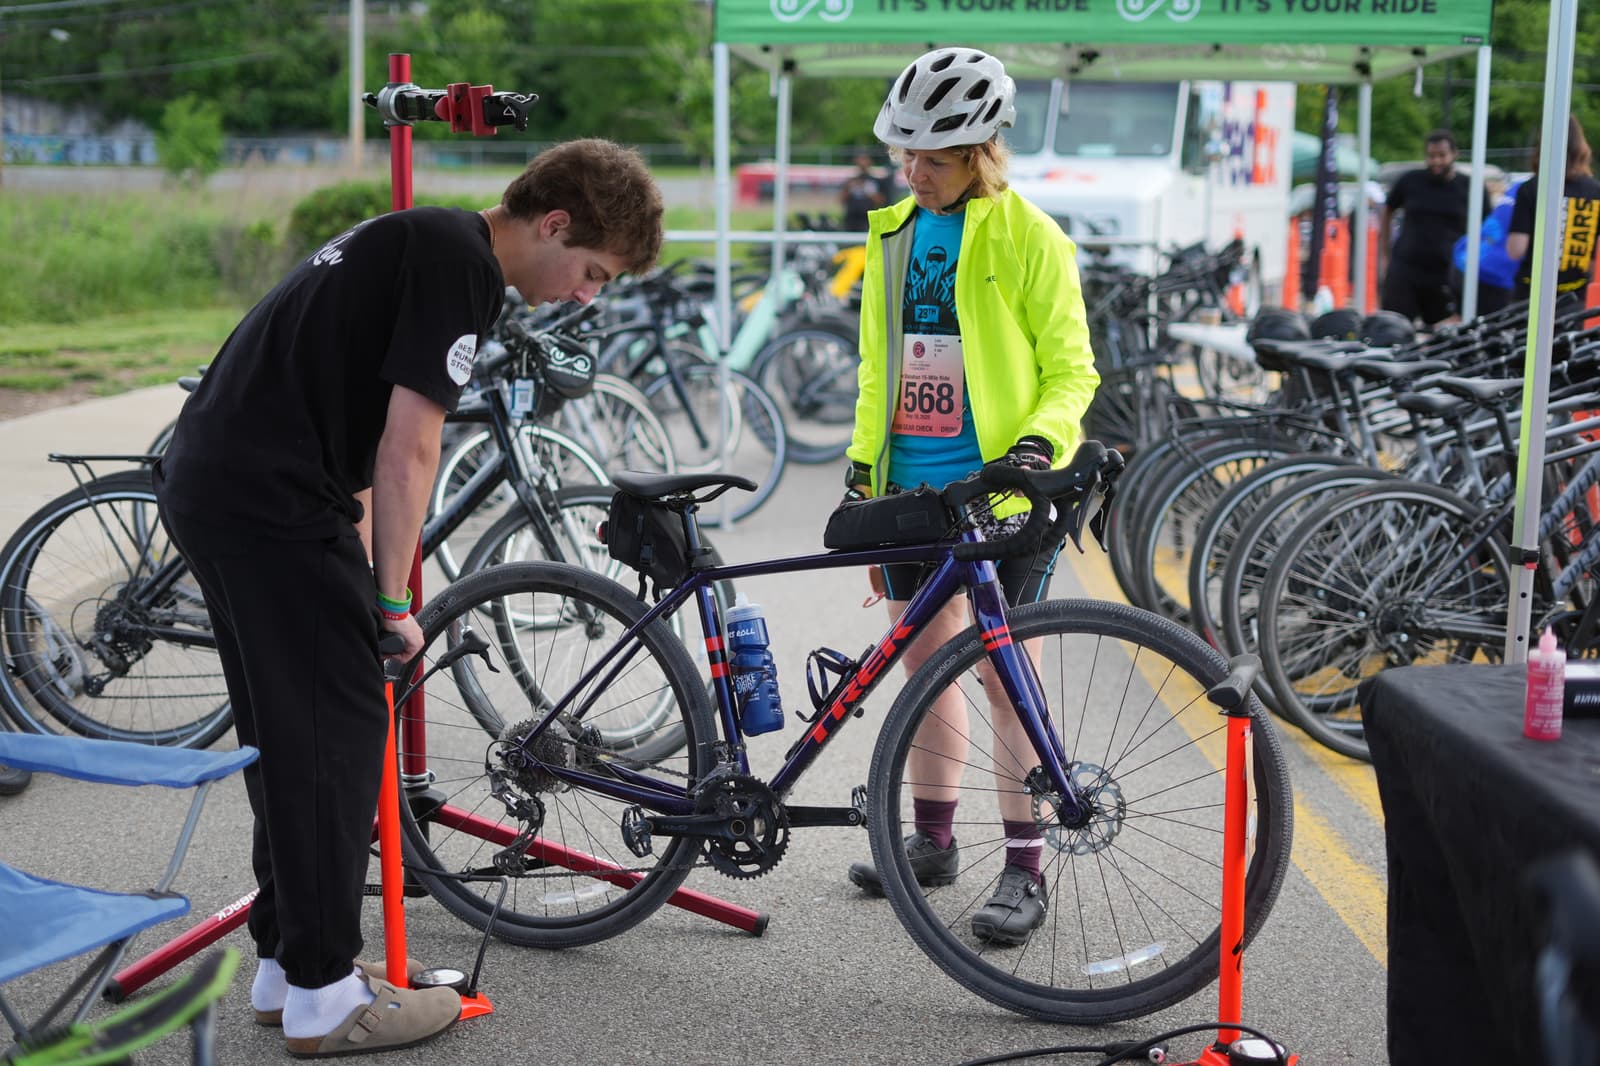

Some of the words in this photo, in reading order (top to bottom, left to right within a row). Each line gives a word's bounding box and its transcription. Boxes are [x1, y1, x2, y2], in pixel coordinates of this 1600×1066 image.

[938, 0, 1015, 13] YOUR
[1023, 0, 1090, 13] RIDE
[1282, 0, 1361, 14] YOUR
[1371, 0, 1438, 14] RIDE
[916, 424, 933, 432] CHECK
[736, 627, 756, 637] ROLL
[932, 654, 958, 680] COMP
[803, 616, 915, 744] TREK
[363, 885, 382, 896] ELITE
